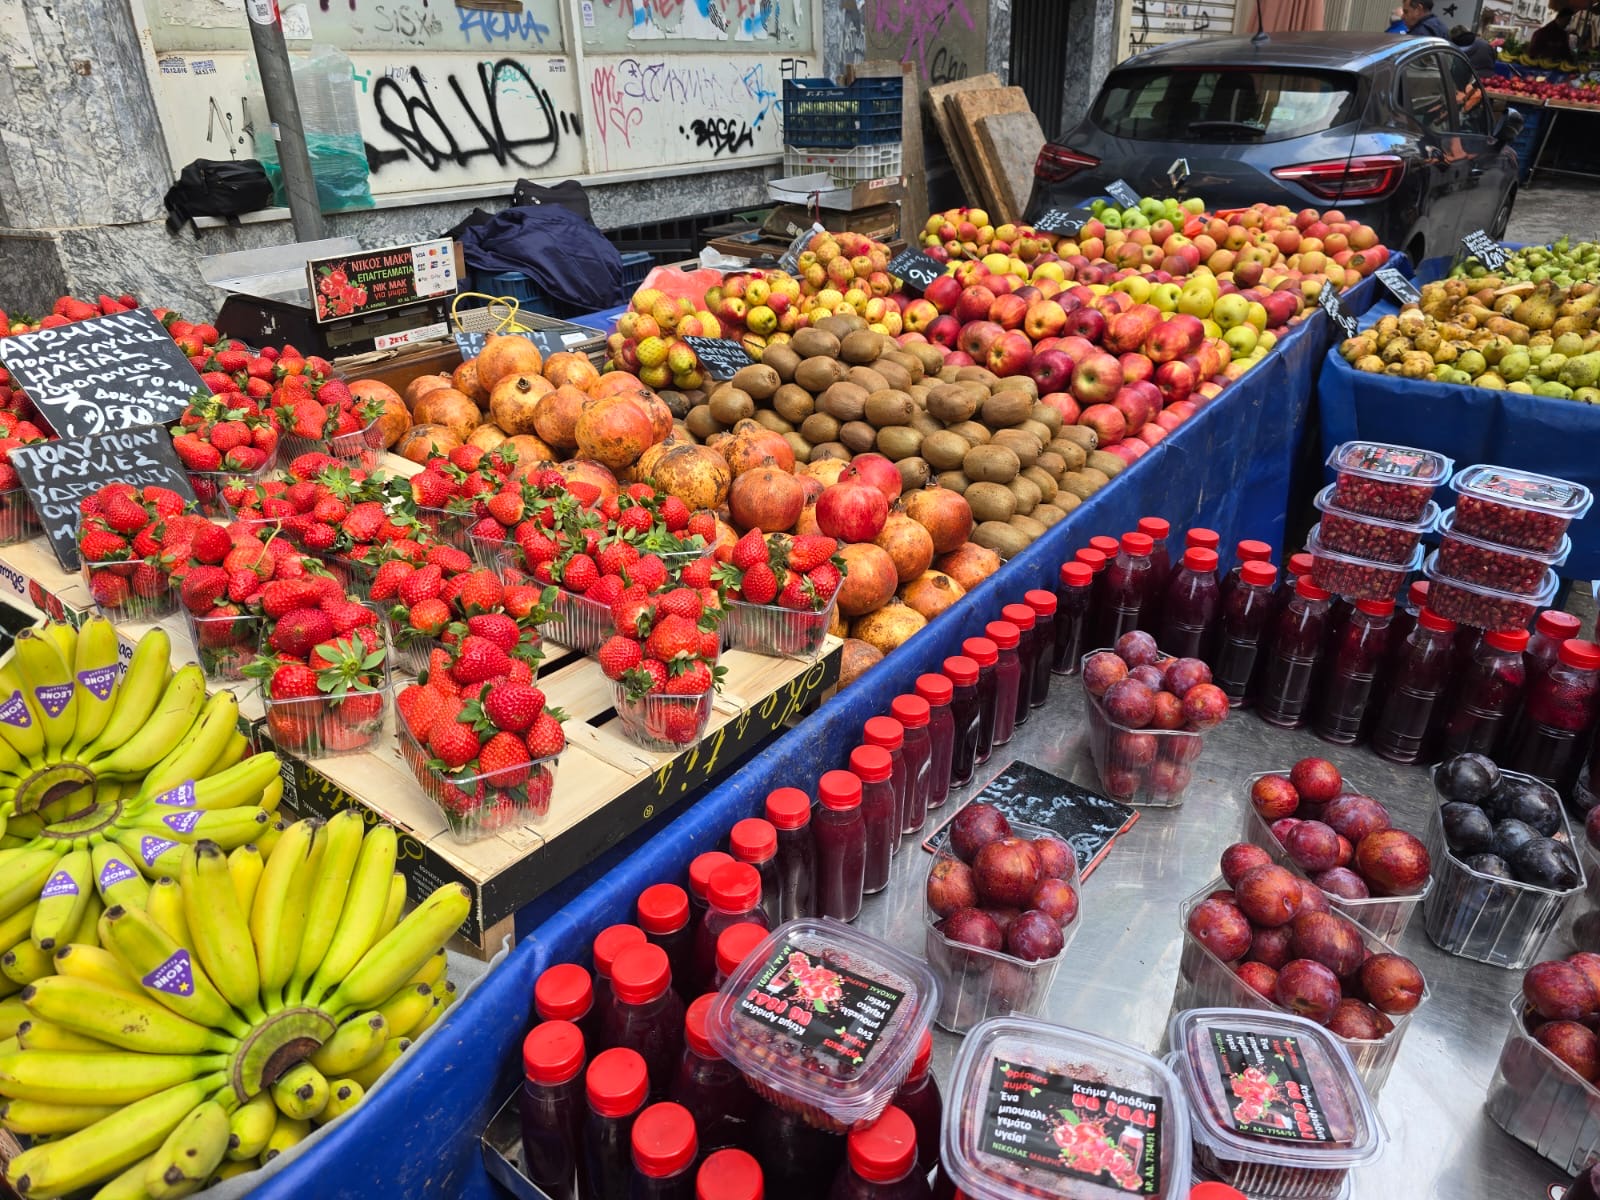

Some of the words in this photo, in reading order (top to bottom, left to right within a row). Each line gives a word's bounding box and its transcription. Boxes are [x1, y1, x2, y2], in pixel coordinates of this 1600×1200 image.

[351, 257, 382, 272] ΝΙΚΟΣ
[373, 282, 387, 293] ΝΙΚ
[388, 278, 408, 290] ΜΑΚ
[11, 428, 158, 469] ΠΟΛΥ-ΠΟΛΥ
[84, 671, 116, 686] LEONE
[40, 690, 73, 700] LEONE
[0, 697, 24, 720] LEONE
[100, 868, 132, 886] LEONE
[42, 883, 76, 897] LEONE
[154, 958, 189, 989] LEONE
[741, 999, 777, 1024] Αριάδνη
[777, 1016, 807, 1036] Κτήμα
[857, 1027, 874, 1041] Ένα
[1000, 1091, 1020, 1103] Ένα
[1072, 1083, 1107, 1098] Κτήμα
[1108, 1091, 1156, 1111] Αριάδνη
[998, 1104, 1047, 1122] μπουκάλι
[997, 1117, 1032, 1131] γεμάτο
[994, 1130, 1026, 1144] υγεία!
[992, 1141, 1028, 1158] ΝΙΚΟΛΑΣ
[1144, 1179, 1155, 1192] ΑΡ.
